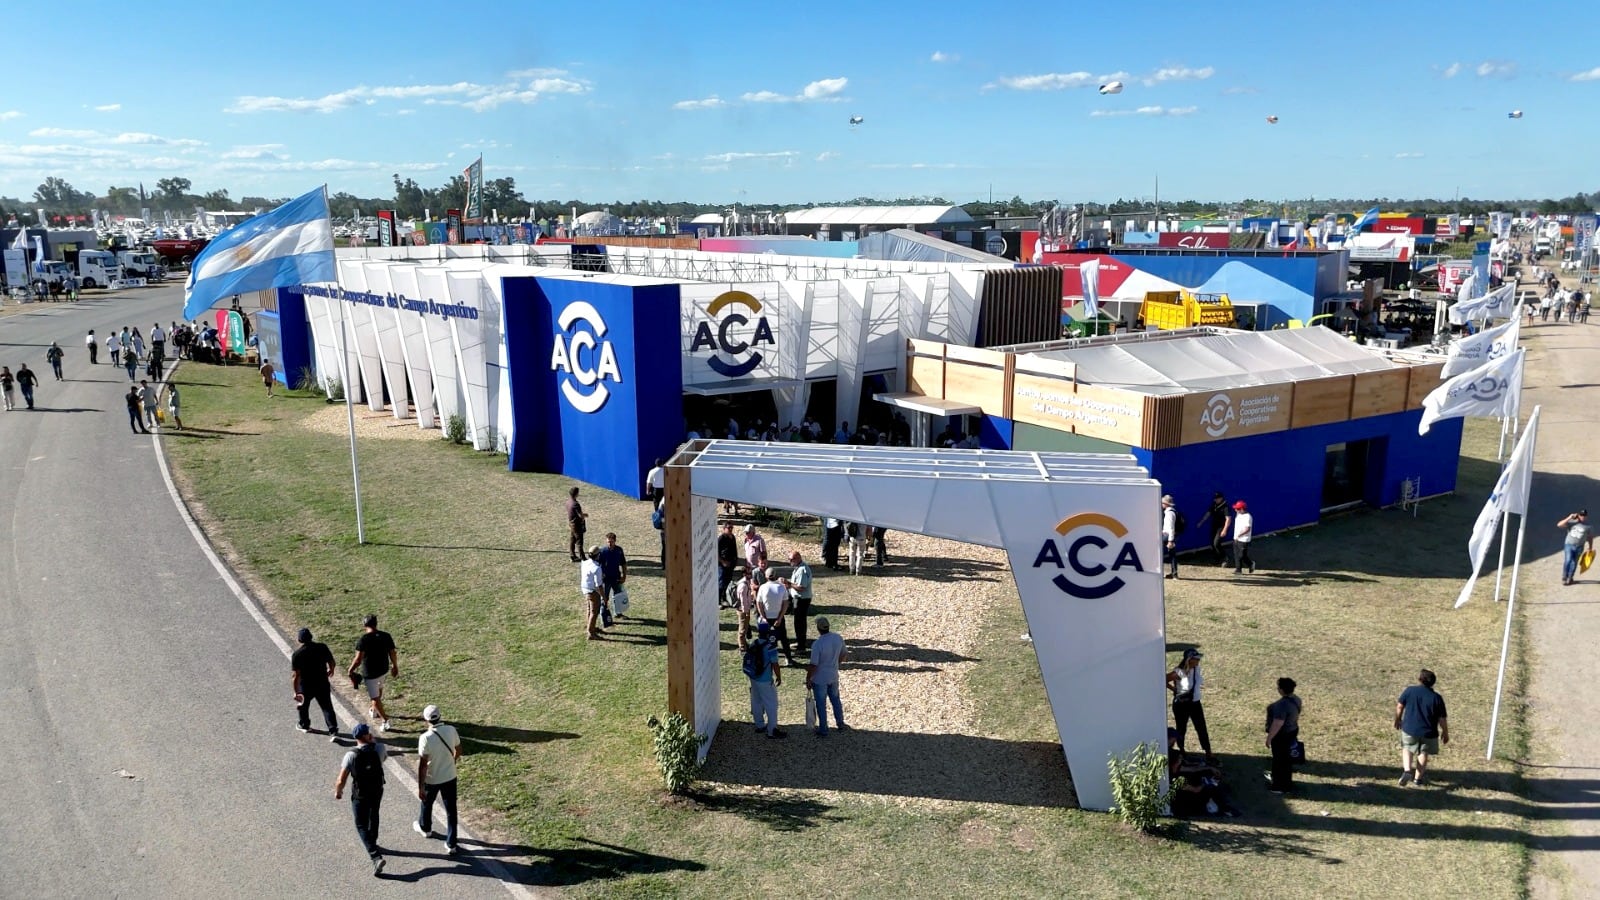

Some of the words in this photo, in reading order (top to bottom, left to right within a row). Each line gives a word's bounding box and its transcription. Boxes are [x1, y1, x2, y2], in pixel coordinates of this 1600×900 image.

[339, 286, 385, 307] Cooperativas
[387, 291, 399, 309] del
[399, 294, 428, 316] Campo
[429, 298, 478, 320] Argentino
[691, 313, 775, 354] ACA
[551, 331, 622, 386] ACA
[1240, 396, 1271, 406] Asociación
[1272, 394, 1280, 403] de
[1240, 405, 1276, 417] Cooperativas
[1200, 405, 1235, 425] ACA
[1239, 415, 1270, 426] Argentinas
[1032, 535, 1144, 577] ACA
